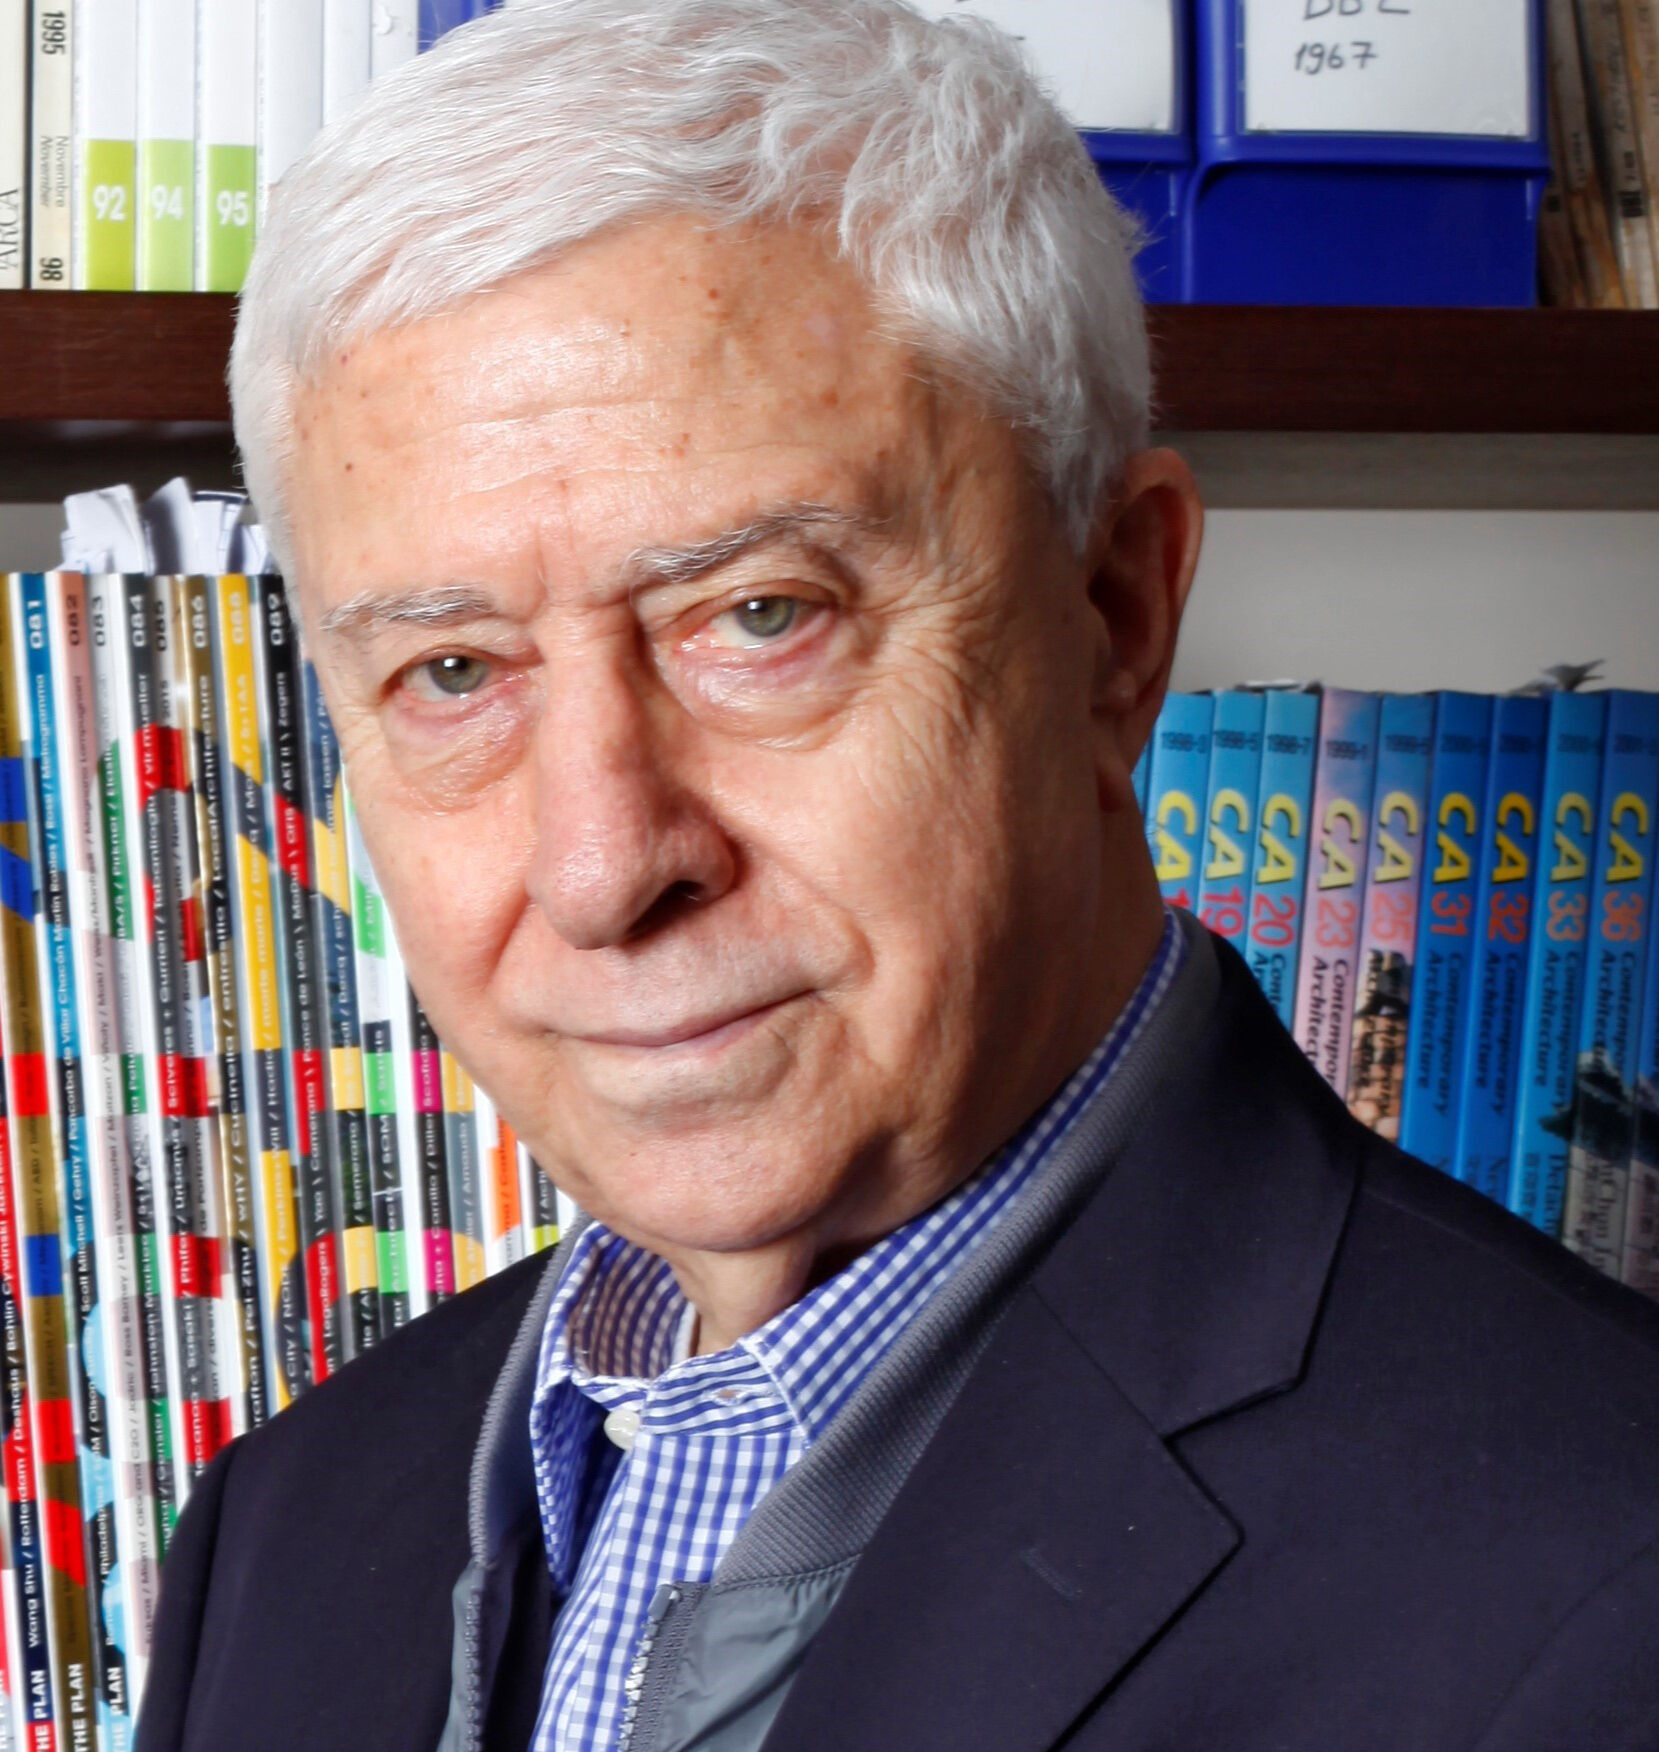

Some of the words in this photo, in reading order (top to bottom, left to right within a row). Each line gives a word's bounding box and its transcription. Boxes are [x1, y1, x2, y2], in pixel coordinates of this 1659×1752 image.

[41, 10, 66, 55] 1995
[1294, 41, 1379, 76] 1967
[39, 135, 54, 207] November
[55, 135, 69, 208] Novembre
[93, 184, 126, 222] 92
[151, 184, 184, 221] 94
[216, 190, 249, 227] 95
[39, 257, 64, 281] 98
[27, 599, 43, 648] 081
[66, 594, 80, 645] 082
[91, 595, 105, 646] 083
[129, 594, 145, 647] 084
[152, 600, 166, 651] 085
[190, 595, 206, 647] 086
[228, 592, 244, 644] 088
[267, 592, 282, 644] 089
[275, 672, 289, 726] Zegers
[35, 674, 51, 778] Metrogramma
[281, 760, 292, 790] AKT
[320, 734, 331, 787] lassen
[43, 794, 55, 828] Rossi
[284, 807, 296, 842] OFIS
[1155, 789, 1198, 881] CA
[1205, 788, 1250, 880] CA
[1375, 791, 1419, 883] CA
[146, 796, 163, 908] Tabanlioglu
[1257, 793, 1300, 885] CA
[1318, 798, 1363, 891] CA
[1433, 791, 1476, 884] CA
[1492, 792, 1534, 883] CA
[1551, 792, 1592, 883] CA
[1606, 792, 1648, 883] CA
[47, 844, 59, 890] Robles
[1163, 888, 1191, 908] 1
[1198, 885, 1245, 937] 19
[1251, 893, 1297, 948] 20
[1315, 897, 1358, 948] 23
[1370, 891, 1413, 943] 25
[1431, 891, 1471, 936] 31
[1488, 892, 1529, 943] 32
[1546, 890, 1586, 942] 33
[1602, 891, 1642, 942] 36
[54, 946, 68, 1003] Chacón
[156, 929, 169, 1002] Gurrieri
[215, 906, 231, 1010] entresitio
[294, 939, 306, 978] León
[336, 956, 347, 1002] Decq
[1253, 952, 1269, 979] Ar
[1269, 953, 1286, 1006] Cont
[298, 983, 307, 1004] de
[1304, 955, 1329, 1065] Architect
[1418, 950, 1443, 1088] Architecture
[1476, 950, 1500, 1088] Architecture
[1534, 950, 1561, 1086] Architecture
[1612, 951, 1635, 1072] Contempor
[59, 1008, 71, 1042] Villar
[300, 1010, 312, 1061] Ponce
[1325, 959, 1349, 1085] Contempor
[1434, 951, 1461, 1117] Contemporary
[1491, 951, 1519, 1115] Contemporary
[62, 1047, 71, 1064] de
[163, 1026, 177, 1107] Sciveres
[264, 1047, 276, 1104] Hadid
[421, 1034, 431, 1105] Scofidio
[64, 1070, 78, 1139] Pancorbo
[225, 1036, 241, 1146] Cucinella
[306, 1082, 320, 1170] Camerana
[379, 1114, 391, 1163] SOM
[425, 1112, 435, 1155] Diller
[71, 1156, 83, 1200] Gehry
[171, 1128, 184, 1208] Urbanus
[234, 1171, 247, 1221] wHY
[429, 1175, 440, 1238] Carrillo
[74, 1215, 87, 1271] Mitchell
[177, 1230, 190, 1283] Phifer
[79, 1276, 90, 1311] Scott
[240, 1247, 255, 1330] Pei-Zhu
[4, 1300, 16, 1350] Bohlin
[183, 1304, 196, 1368] Sasaki
[285, 1339, 297, 1376] City
[9, 1368, 23, 1439] Deshaus
[87, 1380, 98, 1422] Olson
[154, 1412, 166, 1480] Gensler
[15, 1458, 31, 1545] Rotterdam
[95, 1486, 110, 1574] Philadelphia
[24, 1564, 35, 1594] Shu
[26, 1598, 39, 1647] Wang
[31, 1669, 48, 1718] PLAN
[68, 1663, 86, 1712] PLAN
[106, 1667, 123, 1715] PLAN
[34, 1725, 50, 1752] HE
